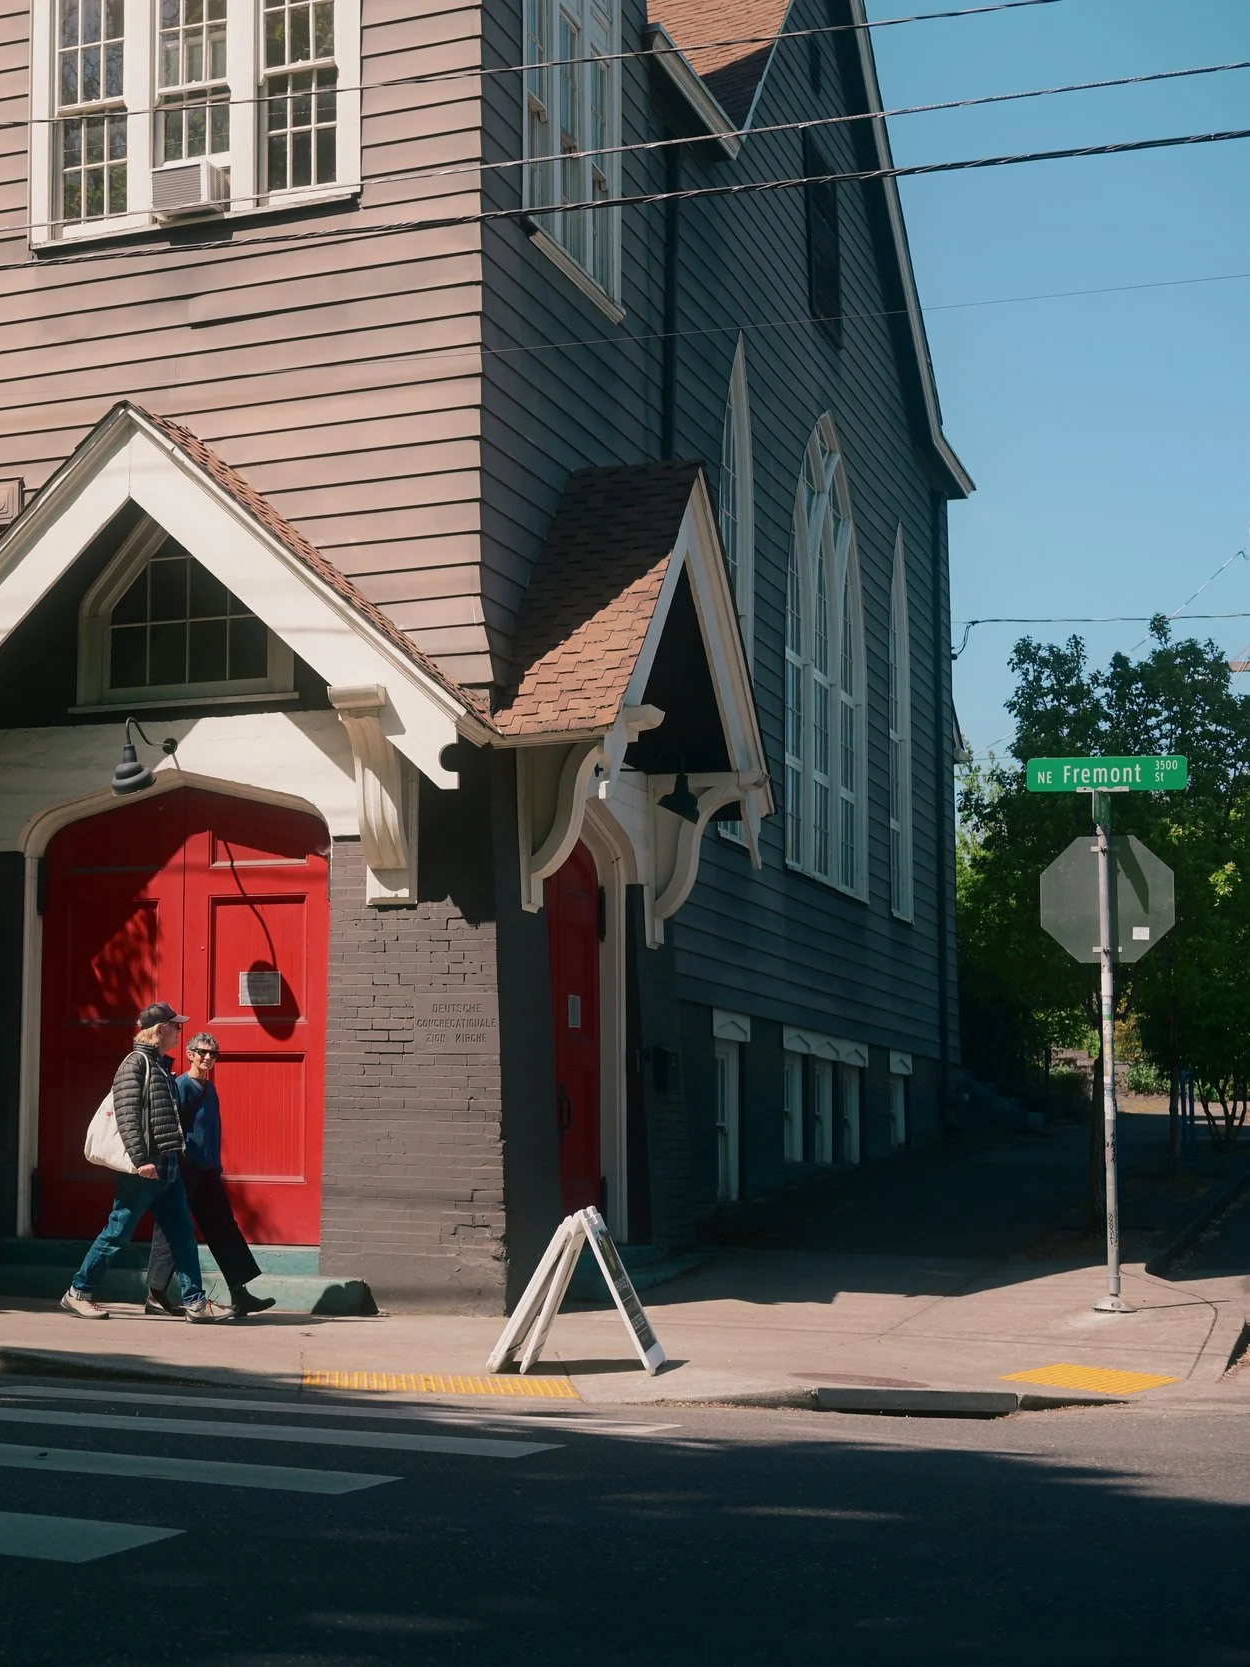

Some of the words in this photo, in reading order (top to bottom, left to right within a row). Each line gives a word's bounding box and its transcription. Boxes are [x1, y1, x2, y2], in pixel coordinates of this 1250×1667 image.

[1154, 760, 1178, 770] 3500
[1037, 771, 1053, 784] NE
[1063, 763, 1142, 784] Fremont
[1154, 772, 1165, 782] St
[432, 1003, 483, 1013] DEUTSCHE
[426, 1033, 446, 1043] ZION
[455, 1033, 487, 1043] KIRCHE
